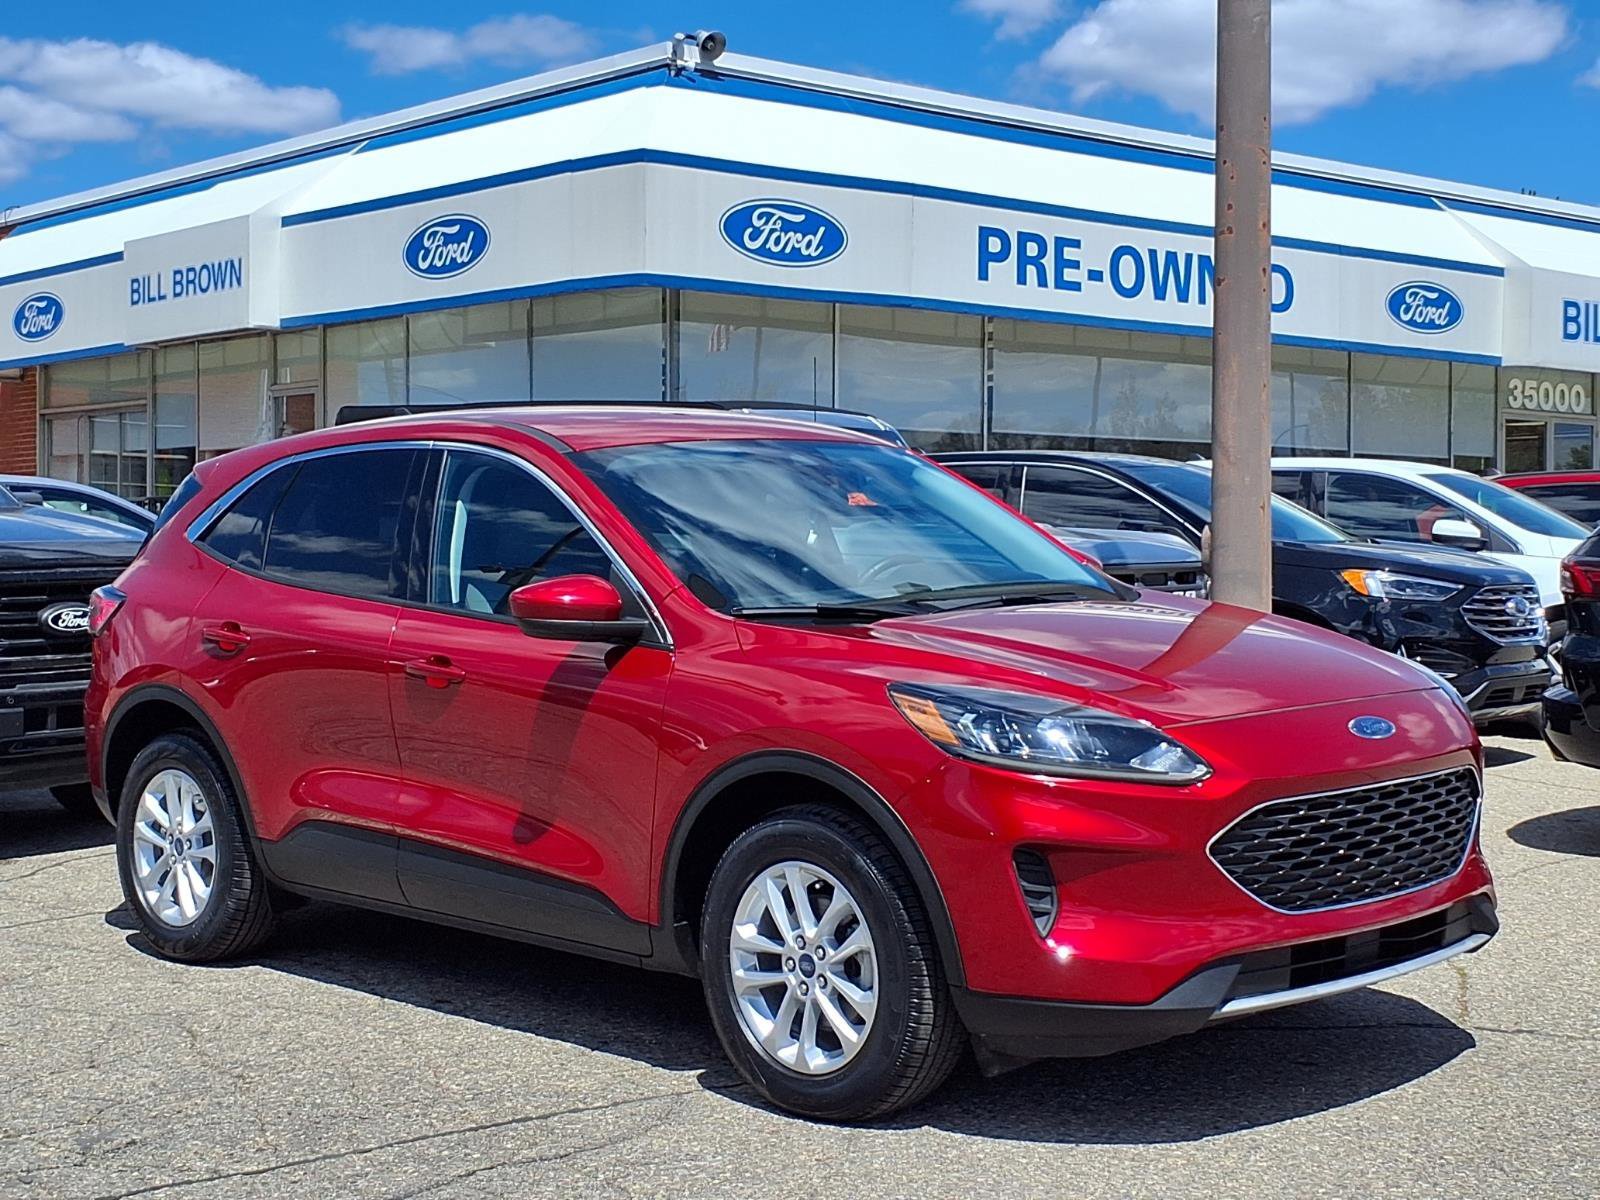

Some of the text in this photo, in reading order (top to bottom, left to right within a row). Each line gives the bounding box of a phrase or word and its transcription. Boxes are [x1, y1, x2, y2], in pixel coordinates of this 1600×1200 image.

[418, 224, 474, 270] Ford
[743, 207, 826, 257] Ford
[130, 257, 243, 305] BILL BROWN
[977, 225, 1295, 313] PRE-OWND
[21, 300, 56, 334] Ford
[1400, 287, 1450, 326] Ford
[1508, 378, 1585, 413] 35000
[58, 610, 90, 627] Ford
